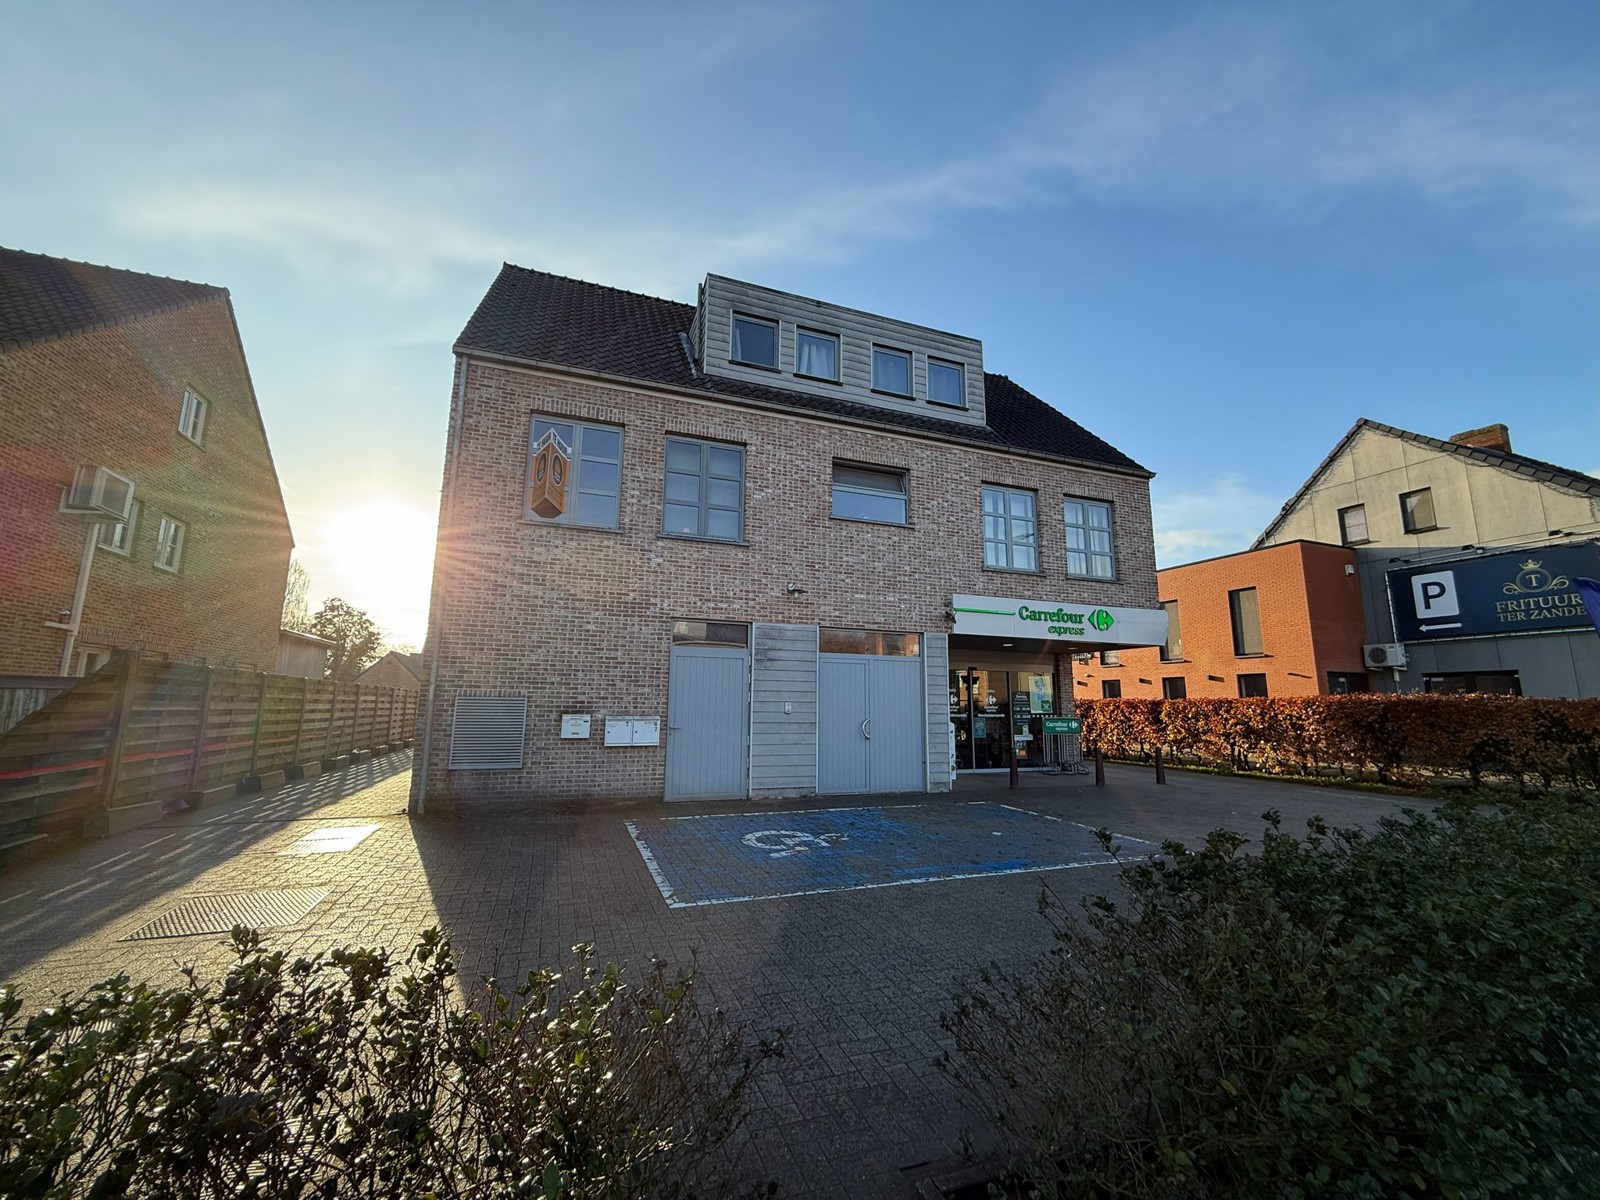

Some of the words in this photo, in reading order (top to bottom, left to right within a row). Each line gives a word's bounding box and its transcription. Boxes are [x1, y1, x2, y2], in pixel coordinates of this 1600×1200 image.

[1526, 574, 1540, 587] T
[1421, 582, 1446, 609] P
[1495, 593, 1583, 612] FRITUUR
[1019, 606, 1084, 624] Carrefour
[1497, 612, 1527, 622] TER
[1530, 606, 1587, 620] ZANDE
[1048, 625, 1085, 636] express
